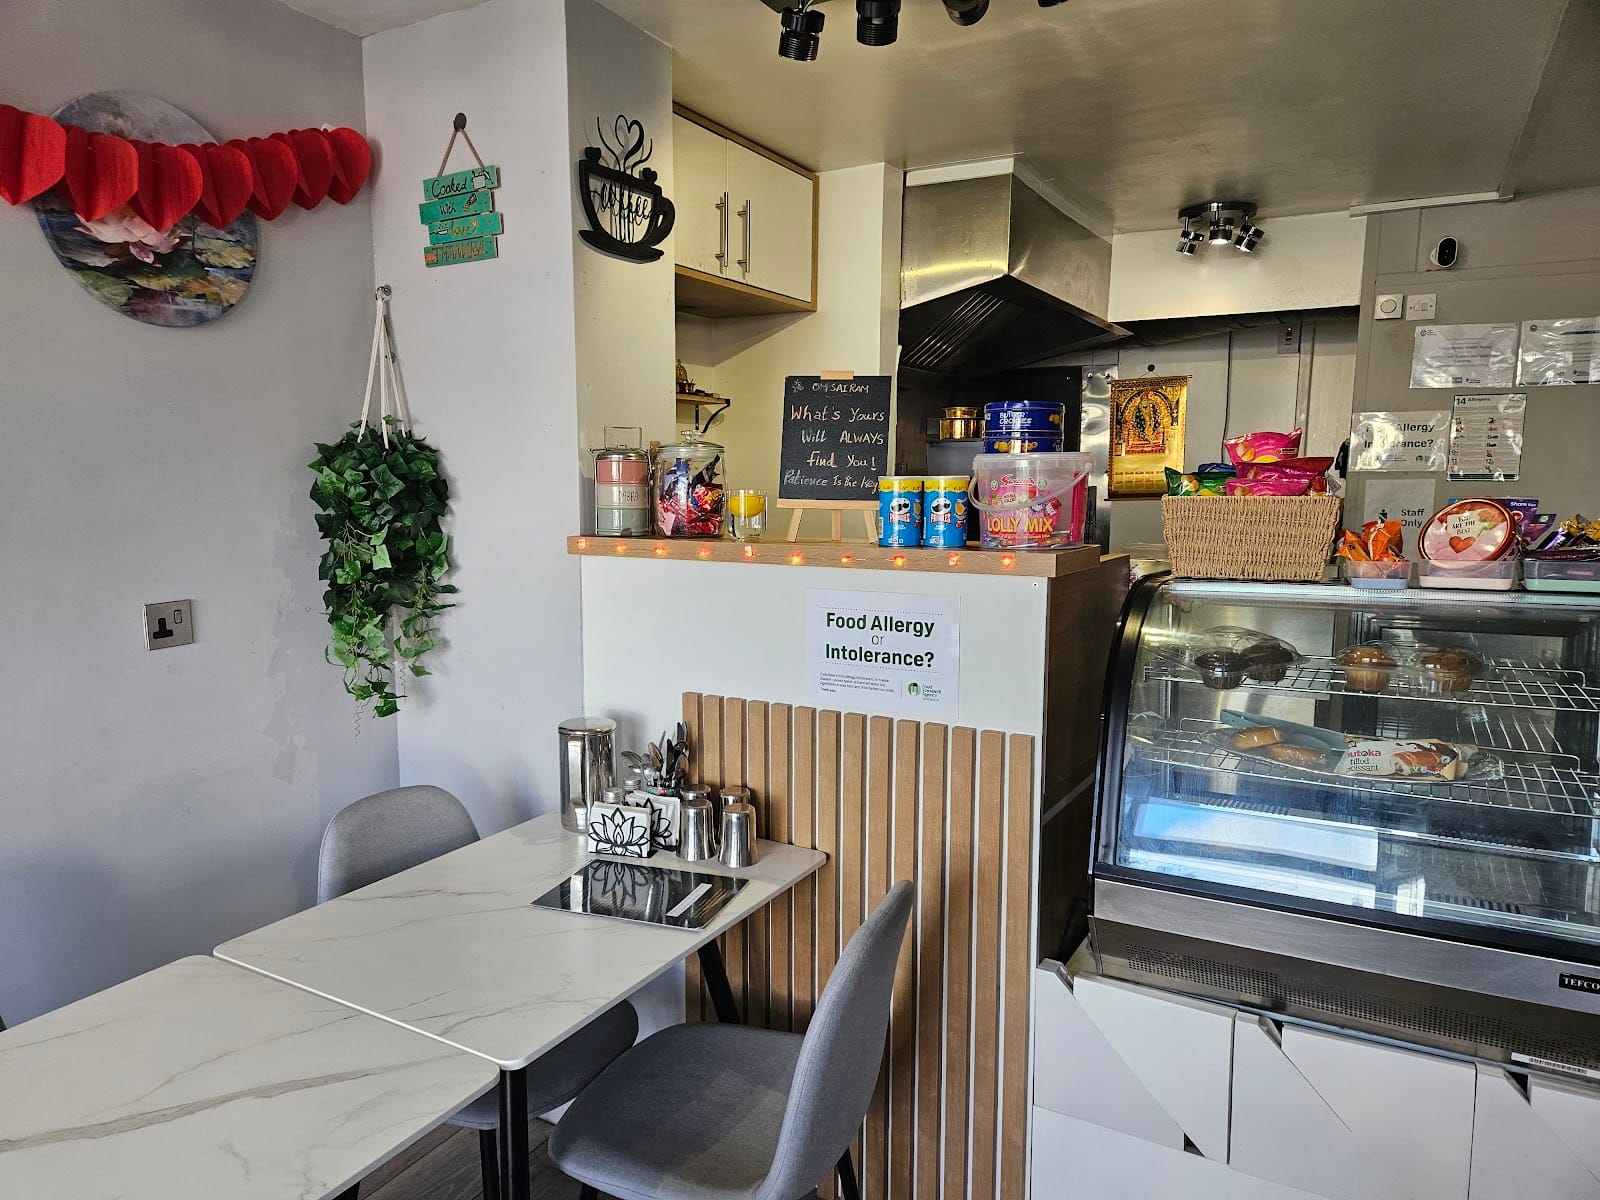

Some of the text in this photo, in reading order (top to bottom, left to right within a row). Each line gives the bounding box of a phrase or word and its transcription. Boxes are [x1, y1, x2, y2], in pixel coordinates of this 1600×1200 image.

[791, 404, 885, 423] What's Yours
[801, 429, 884, 445] Will ALWAYS
[1397, 423, 1435, 433] Allergy
[806, 450, 838, 468] Find
[1401, 508, 1424, 517] Staff
[986, 516, 1054, 534] LOLLY MIX
[1401, 519, 1423, 529] Only
[826, 612, 935, 638] Food Allergy
[825, 643, 935, 668] Intolerance?
